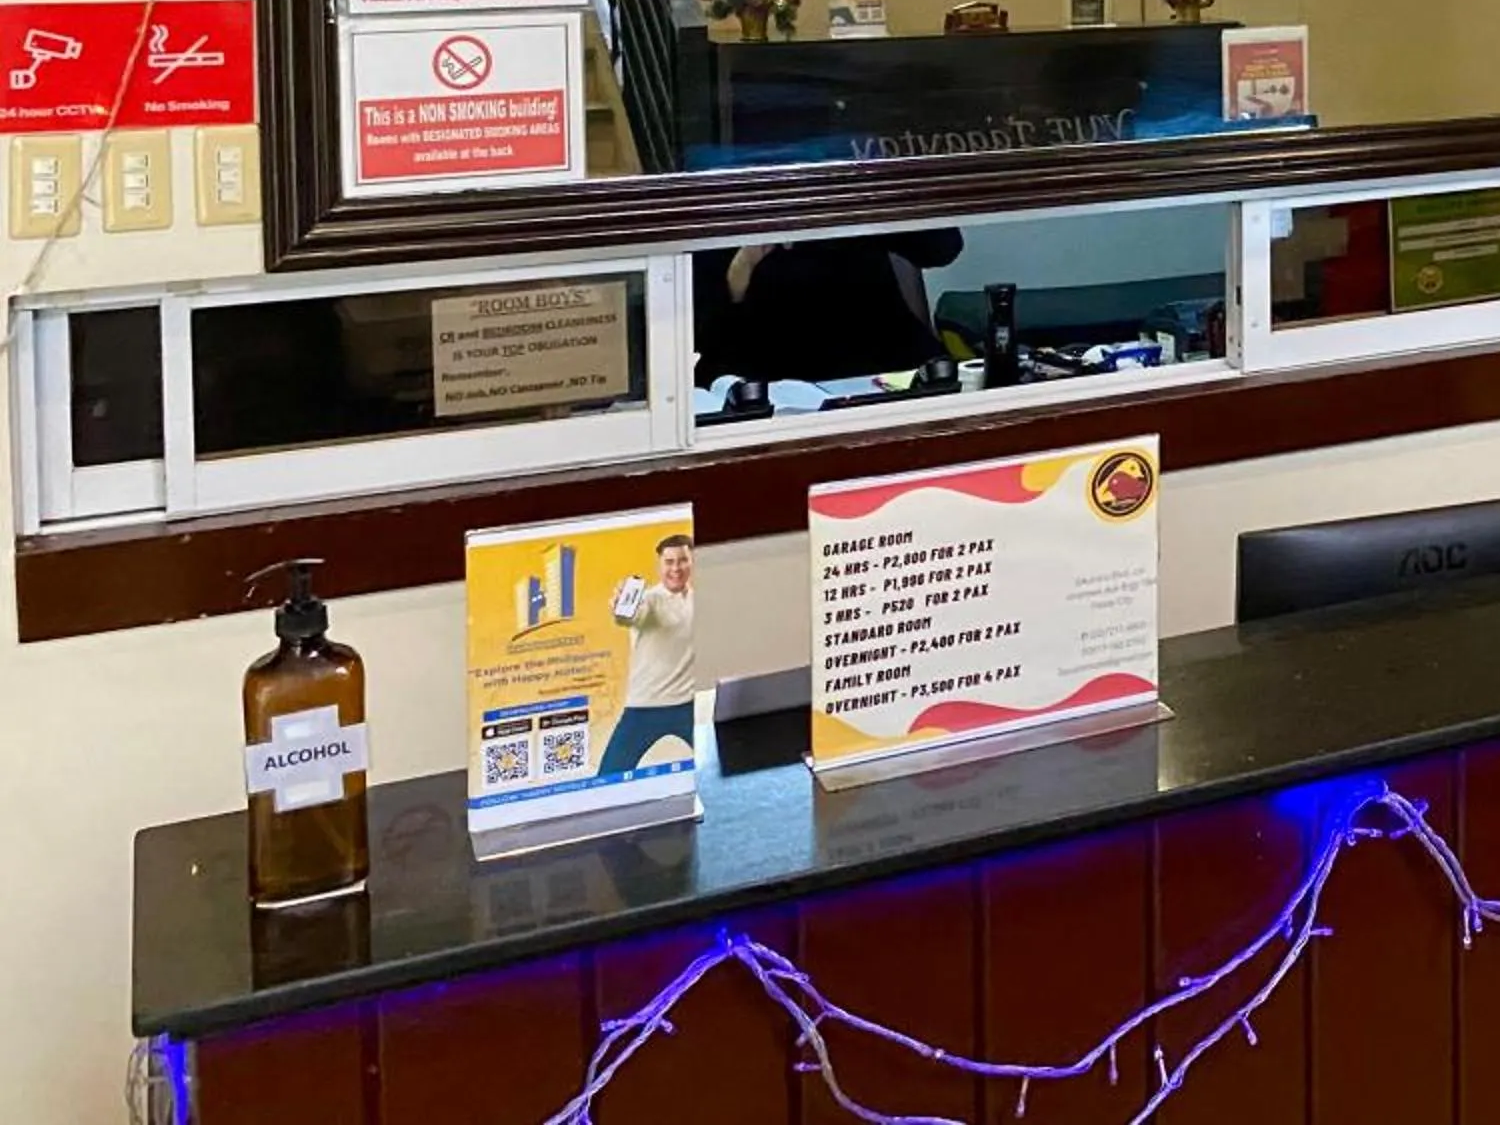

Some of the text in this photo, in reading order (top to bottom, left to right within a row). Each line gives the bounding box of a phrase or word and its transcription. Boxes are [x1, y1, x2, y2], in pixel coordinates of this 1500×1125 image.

[19, 107, 52, 117] hour
[144, 99, 231, 113] No Smoking
[364, 107, 390, 126] This
[394, 106, 404, 124] is
[406, 109, 416, 123] a
[419, 103, 446, 123] NON
[449, 100, 506, 121] SMOKING
[402, 131, 421, 143] with
[423, 127, 482, 141] DESIGNATED
[484, 125, 529, 138] SMOKING
[530, 122, 560, 135] AREAS
[414, 145, 513, 162] available at the back
[458, 330, 479, 340] and
[467, 345, 498, 358] YOUR
[528, 335, 598, 353] OBLIGATION
[824, 531, 913, 557] GARAGE ROOM
[824, 567, 840, 579] 24
[844, 560, 870, 575] HRS
[883, 551, 926, 569] P2,800
[930, 546, 954, 562] FOR
[958, 544, 966, 556] 2
[968, 539, 994, 555] PAX
[824, 589, 838, 602] 12
[842, 583, 867, 599] HRS
[928, 568, 952, 583] FOR
[956, 567, 964, 579] 2
[967, 561, 992, 577] PAX
[836, 607, 862, 623] HRS
[882, 597, 914, 615] P520
[925, 592, 949, 607] FOR
[952, 590, 960, 601] 2
[963, 583, 989, 599] PAX
[824, 617, 932, 647] STANDARD ROOM
[825, 645, 897, 670] OVERNIGHT
[910, 635, 955, 653] P2,400
[958, 630, 982, 645] FOR
[985, 627, 994, 639] 2
[996, 621, 1022, 638] PAX
[524, 661, 545, 669] the
[825, 664, 912, 693] FAMILY ROOM
[826, 689, 898, 715] OVERNIGHT
[911, 679, 955, 699] P3,500
[957, 673, 980, 689] FOR
[984, 671, 992, 682] 4
[996, 665, 1022, 681] PAX
[264, 740, 352, 771] ALCOHOL
